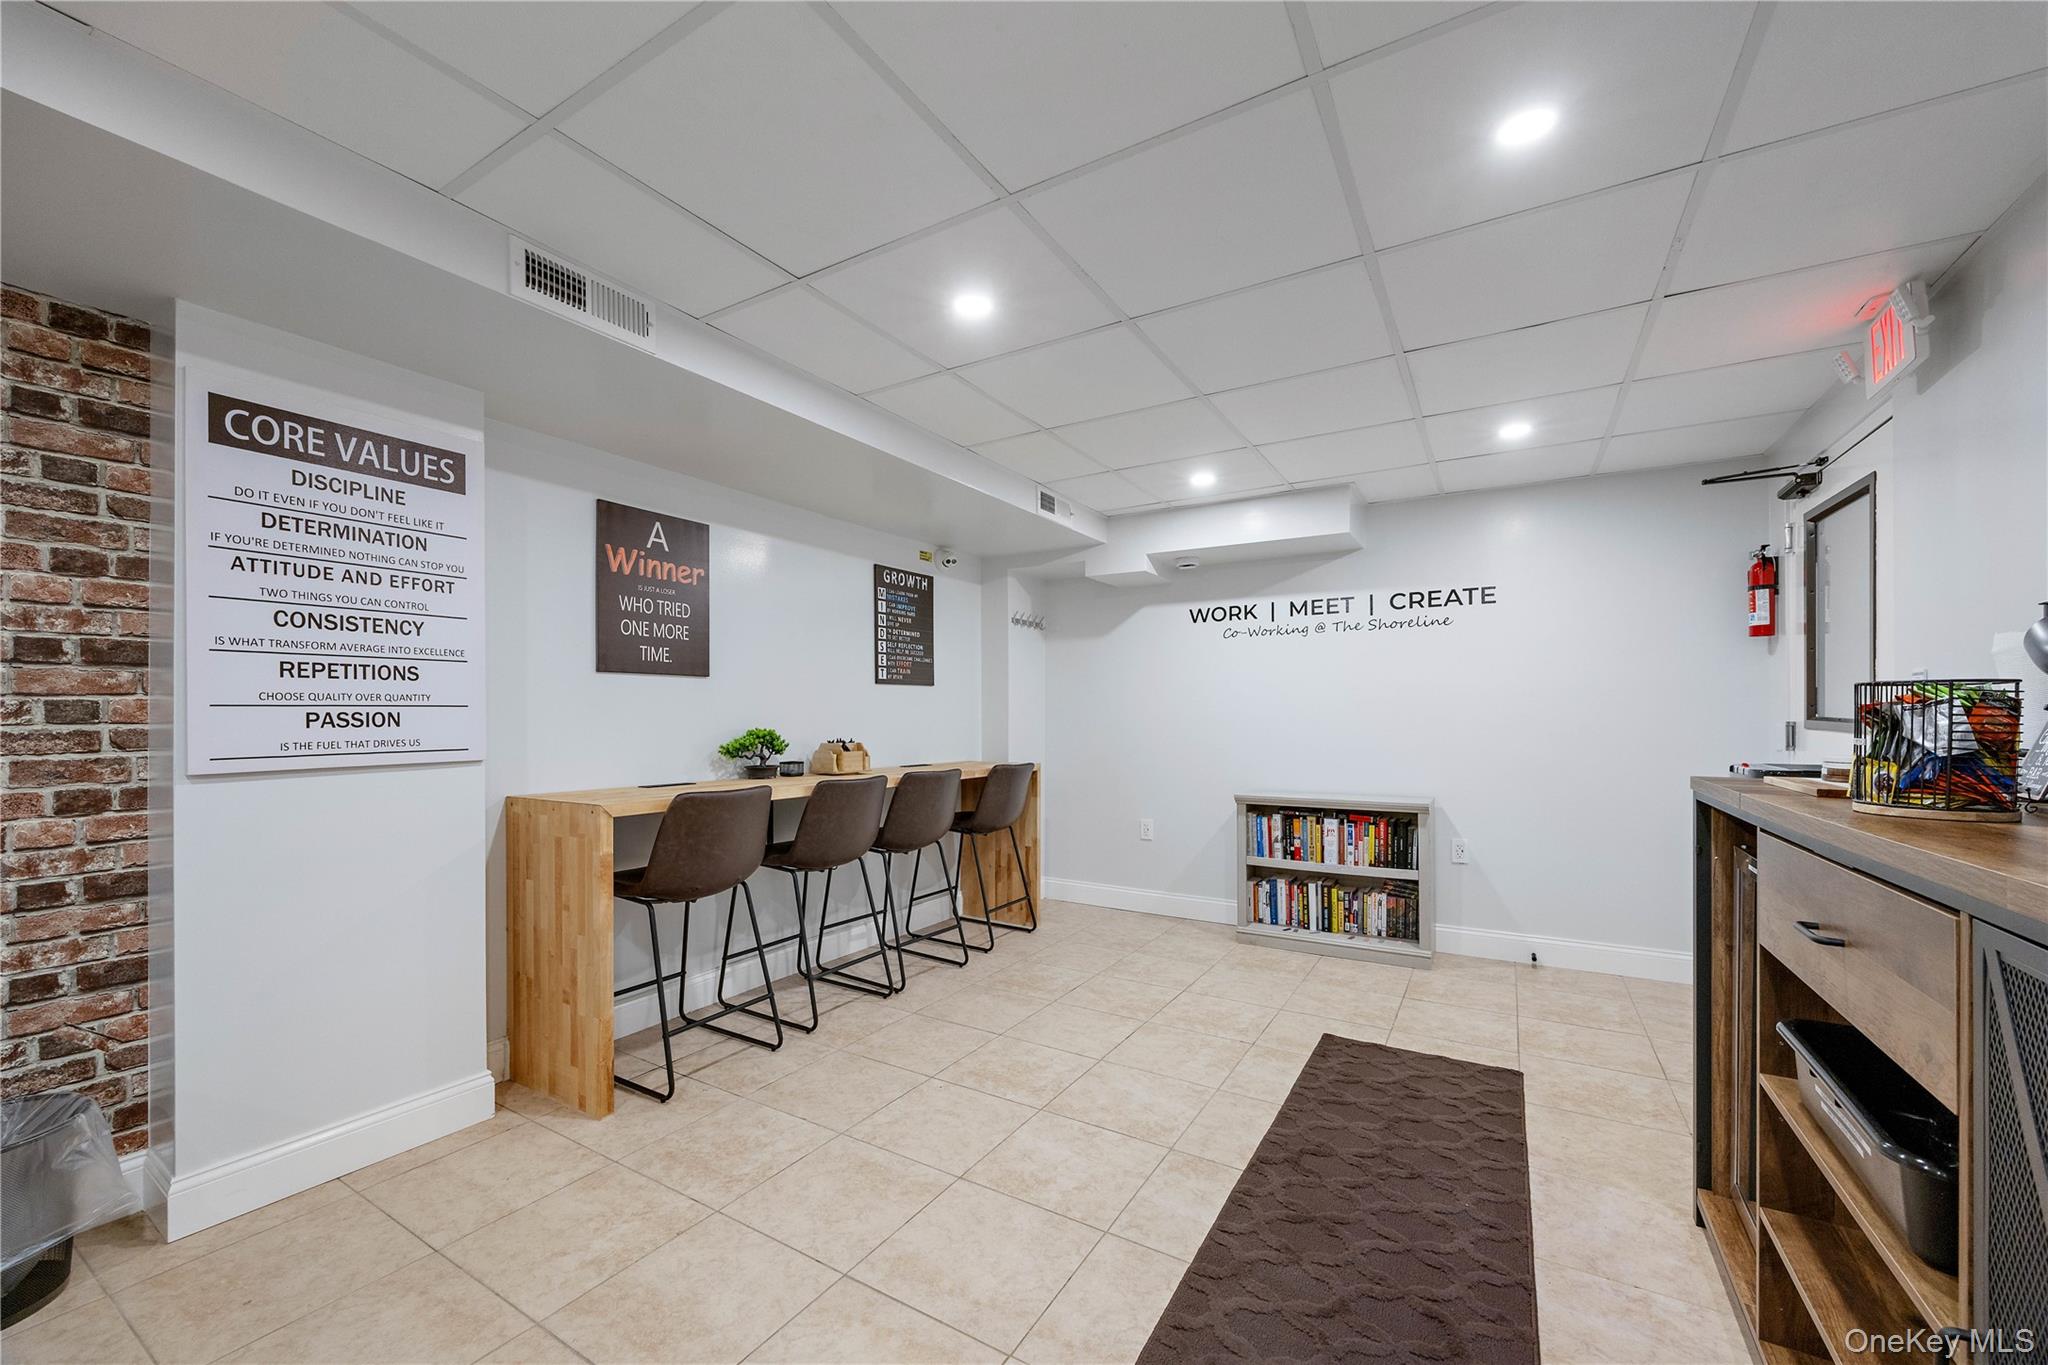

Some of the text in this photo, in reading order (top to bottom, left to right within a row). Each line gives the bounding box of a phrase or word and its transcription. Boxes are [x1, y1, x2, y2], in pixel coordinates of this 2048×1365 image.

[1872, 305, 1904, 384] EXIT
[225, 409, 455, 484] CORE VALUES
[292, 469, 406, 506] DISCIPLINE
[234, 486, 444, 531] DO IT EVEN IF YOU DON'T FEEL LIKE IT
[262, 512, 428, 552] DETERMINATION
[646, 521, 669, 552] A
[210, 532, 464, 574] IF YOU'RE DETERMINED NOTHING CAN STOP YOU
[604, 544, 704, 586] Winner
[230, 556, 455, 594] ATTITUDE AND EFFORT
[884, 570, 928, 590] GROWTH
[260, 587, 429, 612] TWO THINGS YOU CAN CONTROL
[618, 595, 690, 618] WHO TRIED
[1189, 604, 1258, 624] WORK
[1290, 596, 1354, 617] MEET
[1390, 586, 1496, 610] CREATE
[274, 610, 424, 637] CONSISTENCY
[620, 619, 690, 640] ONE MORE
[1222, 614, 1455, 640] Co-Working @ The Shoreline
[214, 636, 464, 658] IS WHAT TRANSFORM AVERAGE INTO EXCELLENCE
[640, 646, 672, 663] TIME.
[280, 661, 420, 682] REPETITIONS
[259, 691, 430, 704] CHOOSE QUALITY OVER QUANTITY
[305, 711, 400, 729] PASSION
[280, 738, 420, 752] IS THE FUEL THAT DRIVES US
